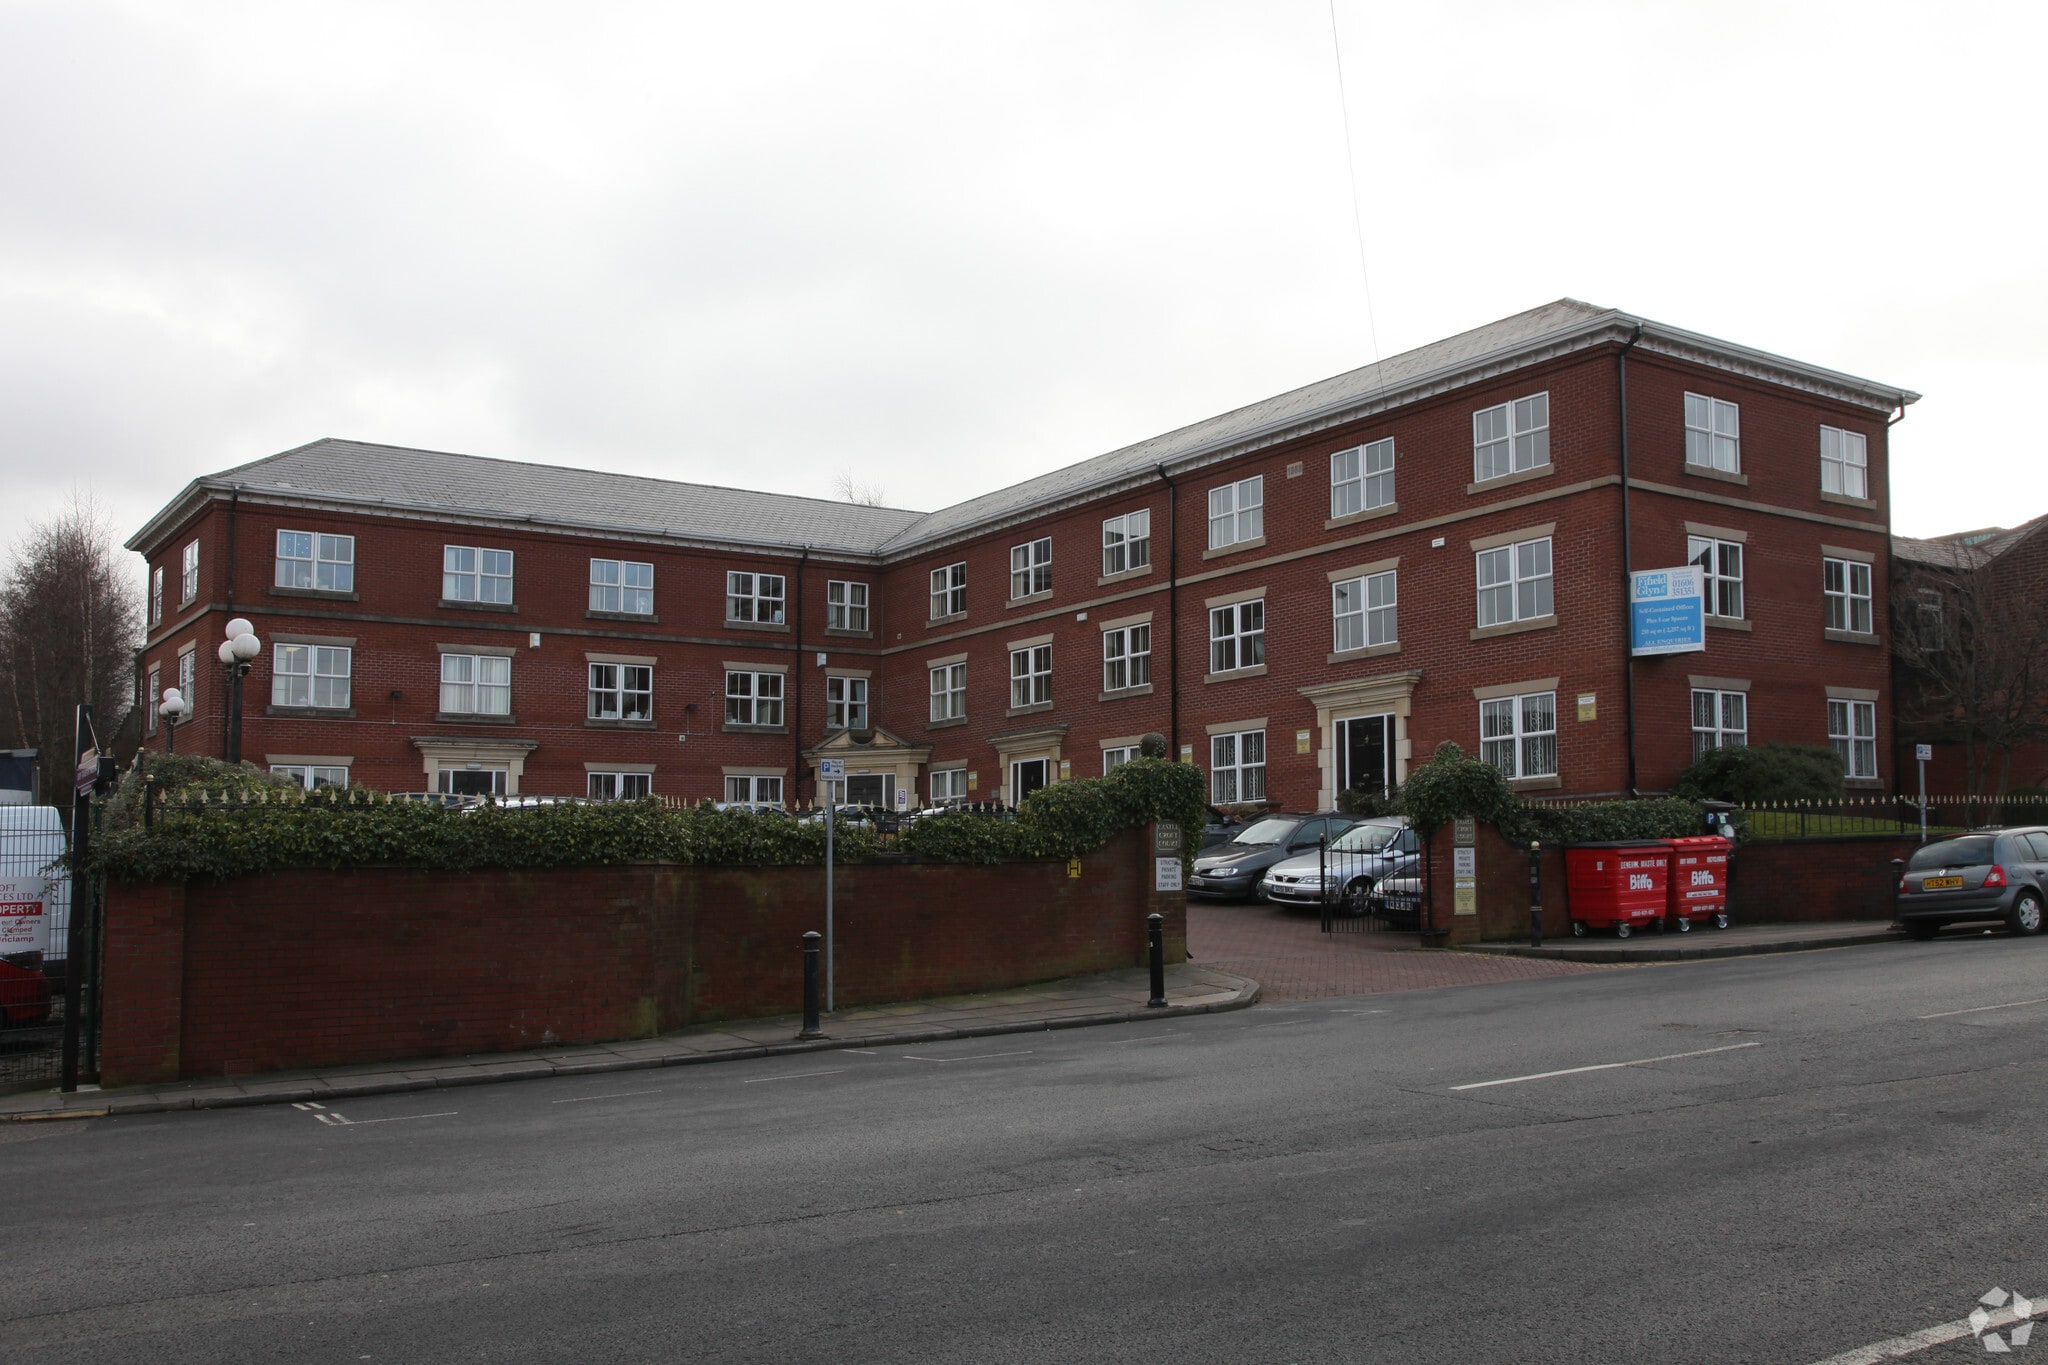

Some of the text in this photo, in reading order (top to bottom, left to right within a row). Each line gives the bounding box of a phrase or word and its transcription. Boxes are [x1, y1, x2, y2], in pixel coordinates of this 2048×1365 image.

[1638, 574, 1666, 586] Fifield
[1672, 579, 1695, 587] 01606
[1637, 586, 1660, 596] Glyn
[1630, 873, 1653, 890] Biffa
[1691, 870, 1714, 886] Biffa
